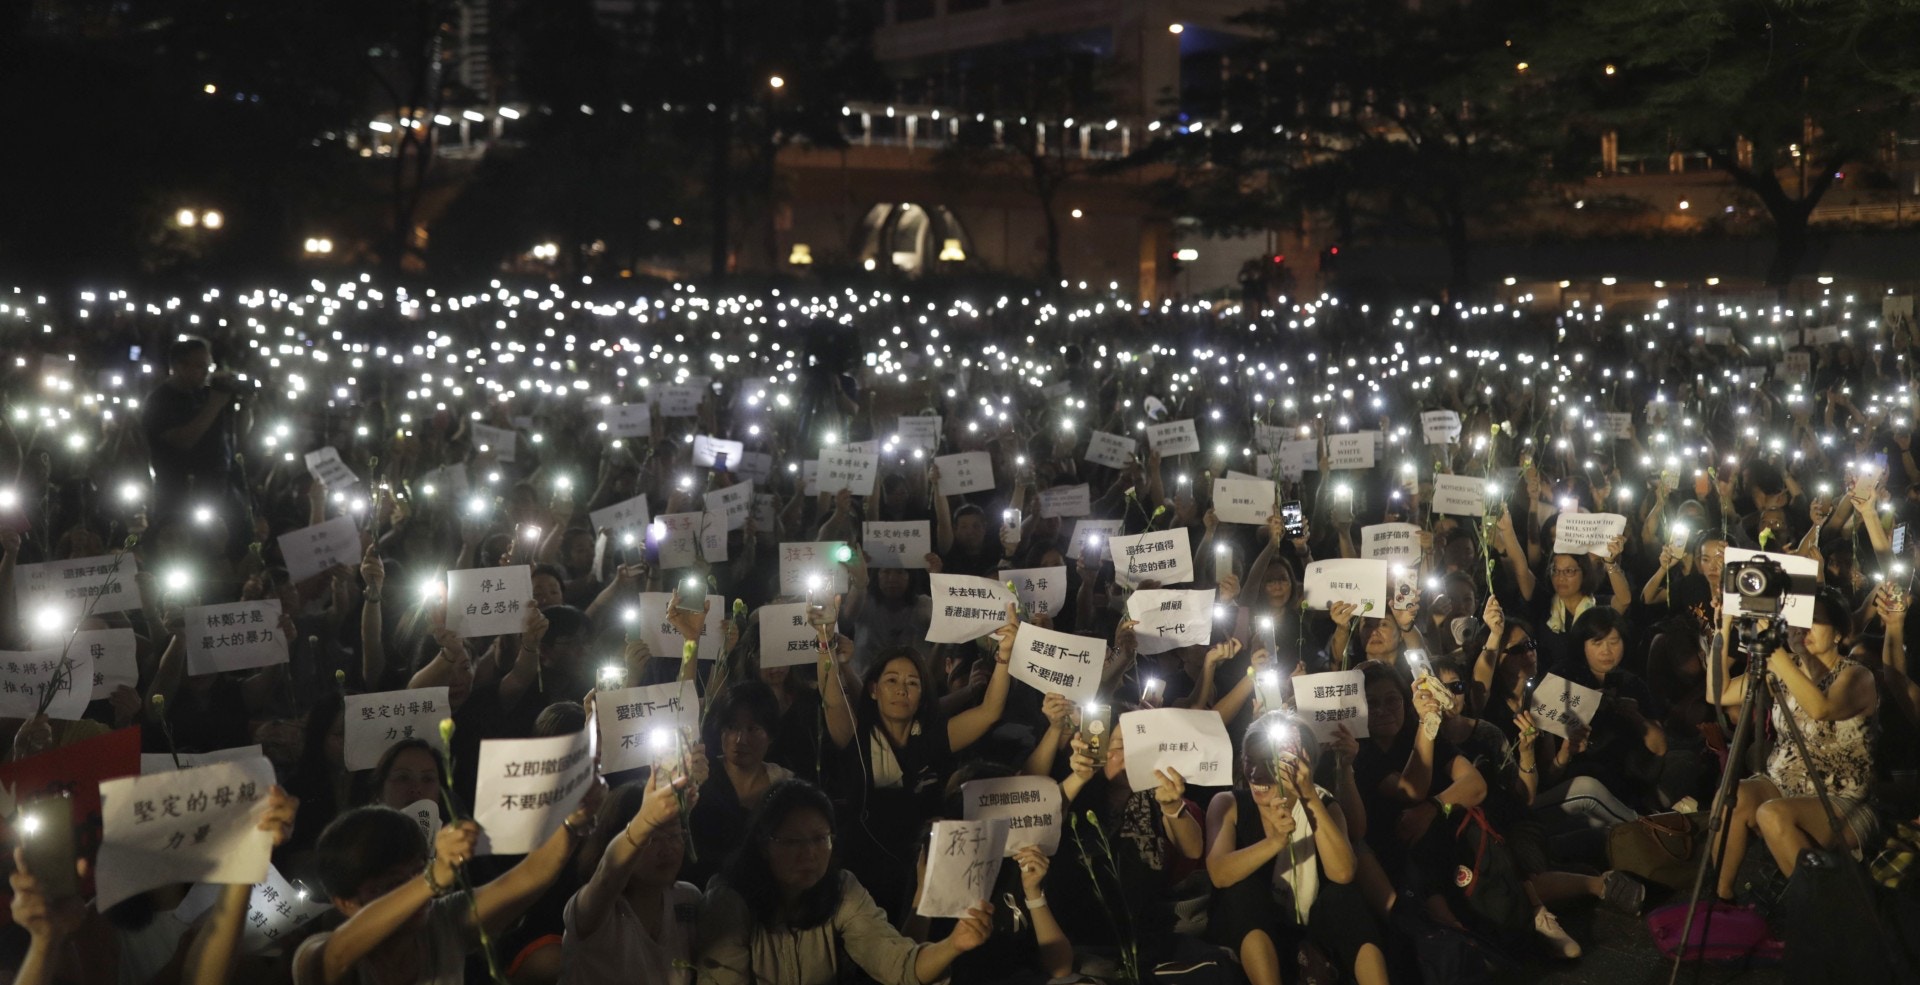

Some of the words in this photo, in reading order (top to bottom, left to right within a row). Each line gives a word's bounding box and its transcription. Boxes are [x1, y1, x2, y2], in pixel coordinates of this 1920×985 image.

[1339, 439, 1358, 447] STOP
[1337, 448, 1361, 456] WHITE
[1565, 518, 1601, 526] WITHDRAW
[1373, 530, 1410, 543] 還孩子值得
[1125, 539, 1175, 557] 還孩子值得
[1128, 558, 1177, 574] 珍愛的香港
[479, 579, 507, 593] 停止
[1024, 577, 1049, 592] 為母
[1329, 581, 1360, 591] 與年輕人
[465, 600, 521, 616] 白色恐怖
[1159, 600, 1183, 613] 關顧
[206, 610, 265, 629] 林鄭才是
[1156, 622, 1186, 637] 下一代
[201, 629, 273, 650] 最大的暴力
[1313, 682, 1359, 700] 還孩子值得
[1559, 691, 1581, 708] 香港
[361, 700, 437, 721] 堅定的母親
[1314, 706, 1359, 723] 珍愛的香港
[1533, 703, 1581, 729] 是我們的
[384, 725, 417, 741] 力量
[1136, 724, 1147, 735] 我
[1158, 741, 1200, 753] 與年輕人
[1199, 760, 1219, 773] 同行
[133, 780, 259, 825] 堅定的母親
[164, 823, 212, 851] 力量
[944, 826, 987, 856] 孩子
